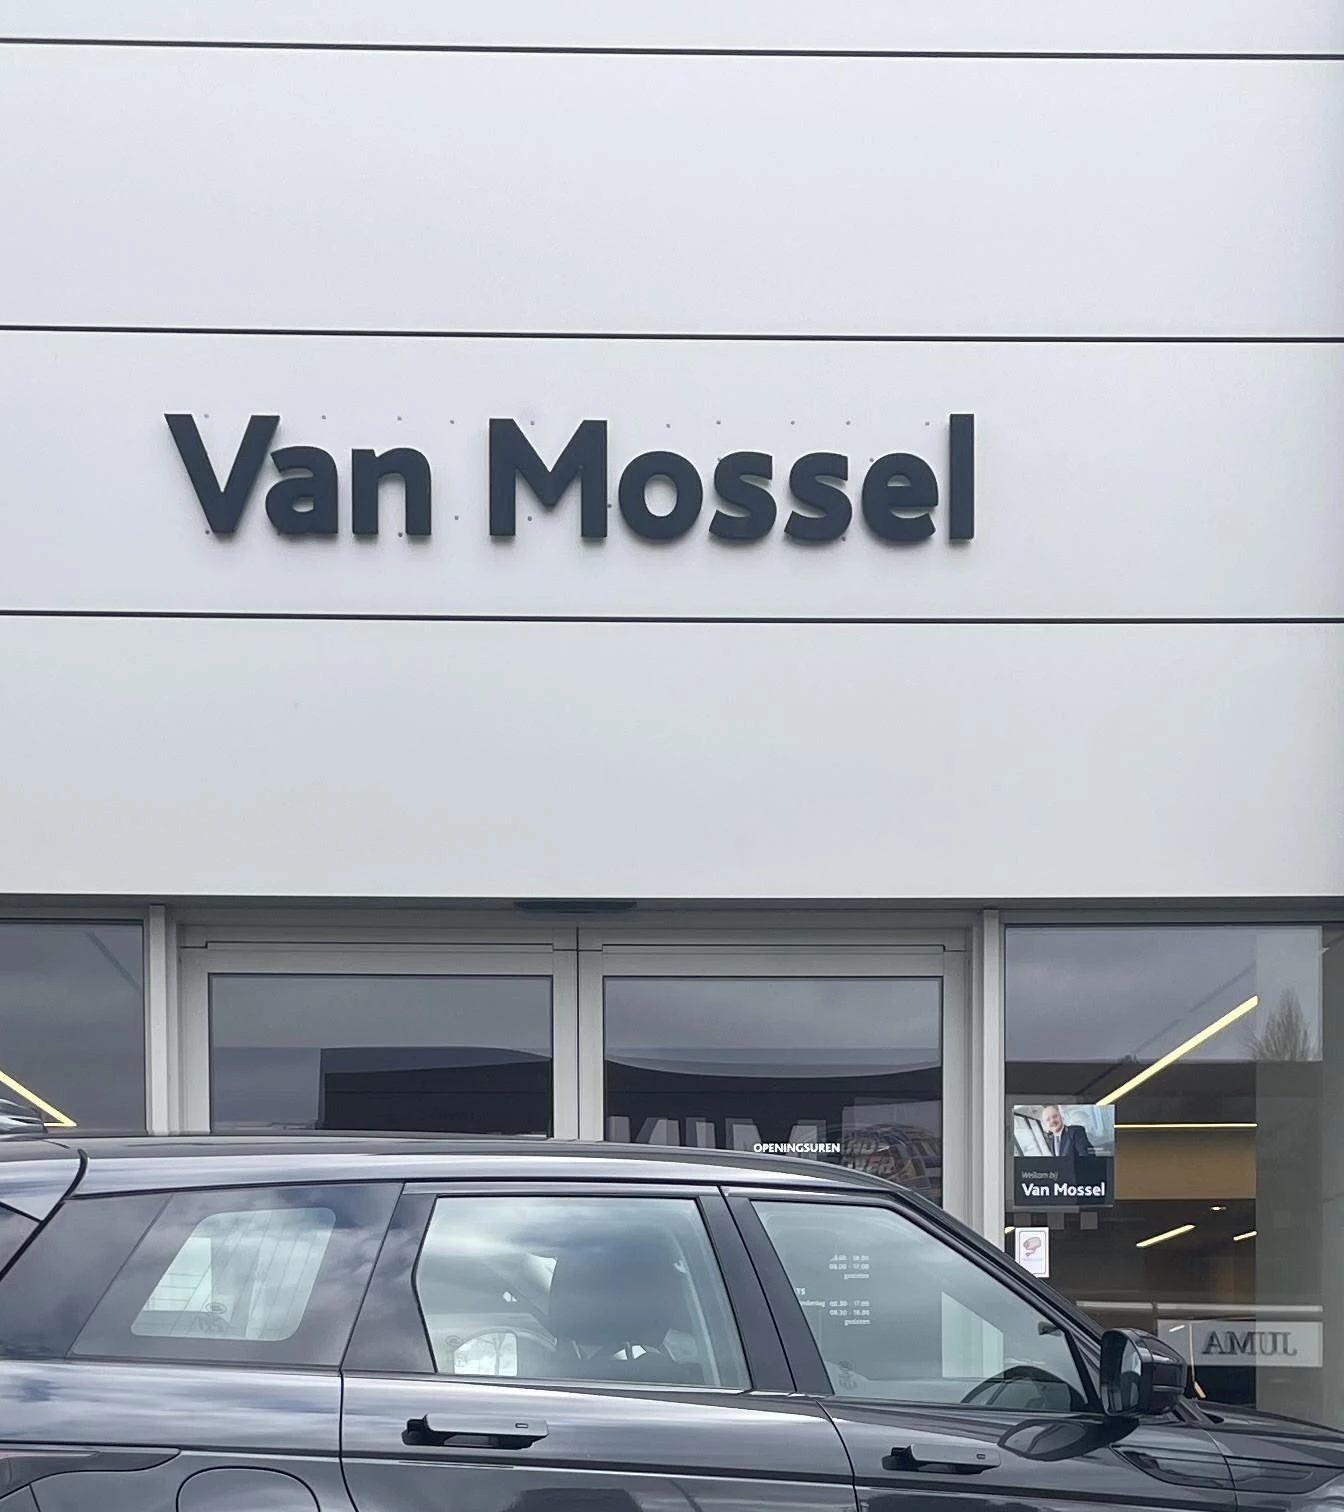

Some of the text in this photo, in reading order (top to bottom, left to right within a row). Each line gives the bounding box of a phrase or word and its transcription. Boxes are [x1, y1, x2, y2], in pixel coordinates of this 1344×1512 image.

[163, 412, 975, 544] Van Mossel
[753, 1142, 841, 1153] OPENINGSUREN
[1021, 1181, 1105, 1197] Van Mossel
